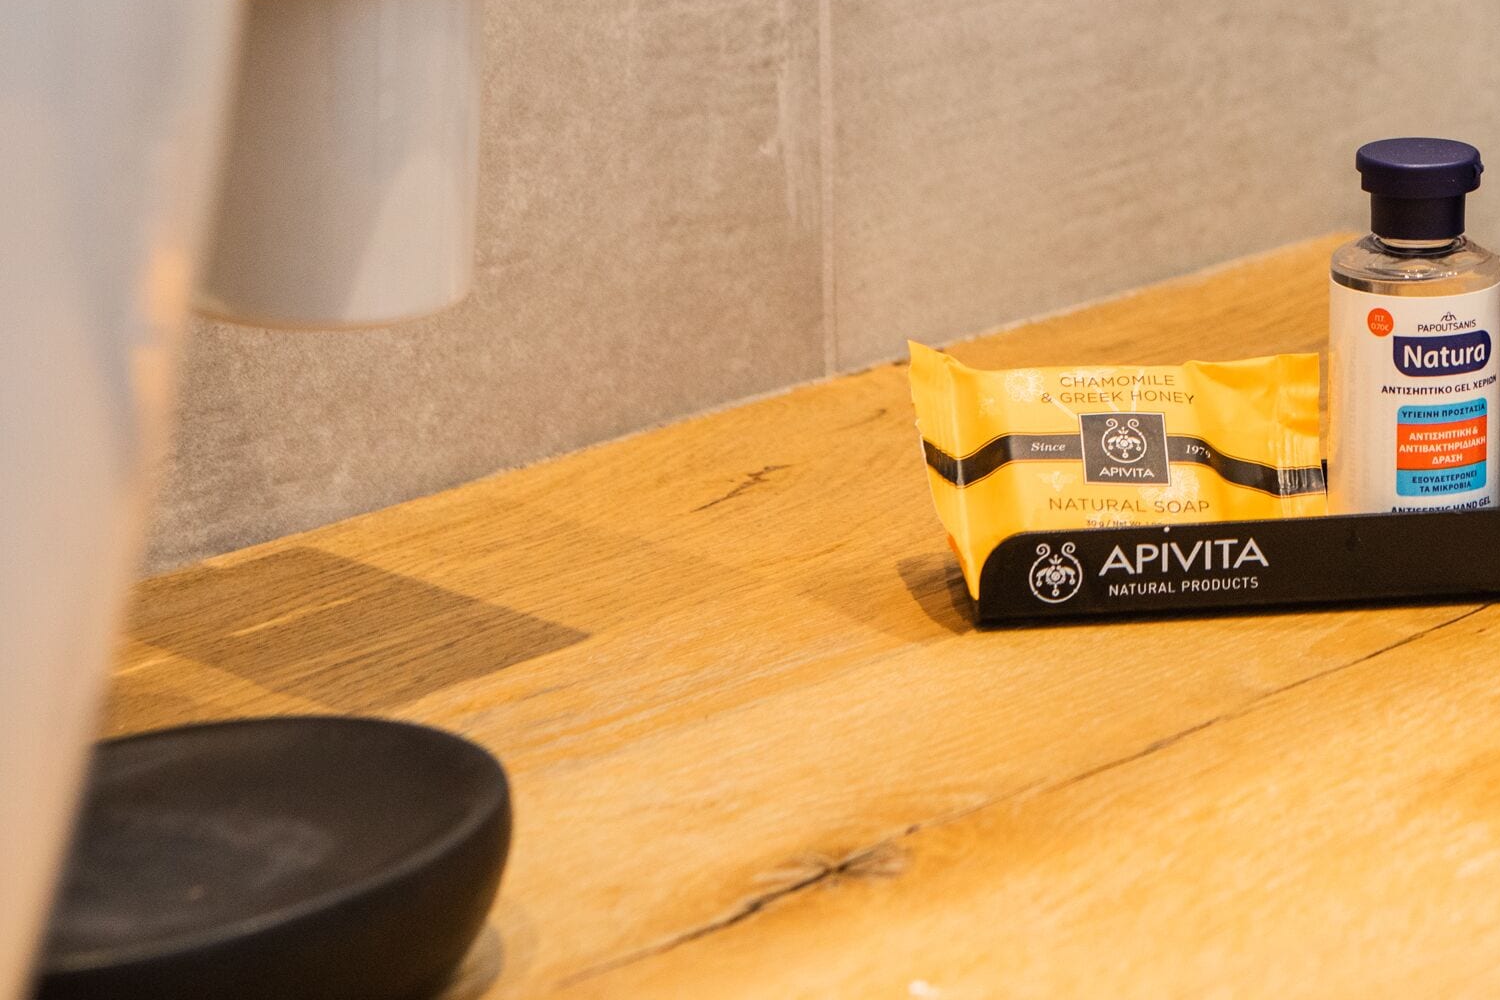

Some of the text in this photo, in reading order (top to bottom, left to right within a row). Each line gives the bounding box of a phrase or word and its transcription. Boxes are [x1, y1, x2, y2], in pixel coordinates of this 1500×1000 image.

[1417, 319, 1477, 333] PAPOUTSANIS
[1403, 343, 1486, 369] Natura
[1060, 375, 1175, 388] CHAMOMILE
[1381, 374, 1497, 395] ΑΝΤΙΣΗΠΤΙΚΟ GEL ΧΕΡΙΩΝ
[1041, 390, 1194, 405] & GREEK HONEY
[1402, 403, 1486, 419] ΥΓΙΕΙΝΗ ΠΡΟΣΤΑΣΙΑ
[1409, 426, 1479, 441] ΑΝΤΙΣΗΠΤΙΚΗ &
[1031, 441, 1066, 452] Since
[1399, 436, 1486, 453] ΑΝΤΙΒΑΚΤΗΡΙΔΙΑΚΗ
[1432, 454, 1463, 465] ΔΡΑΣΗ
[1099, 466, 1155, 478] APIVITA
[1411, 470, 1478, 484] ΕΞΟΥΔΕΤΕΡΩΝΕΙ
[1420, 481, 1472, 493] ΤΑ ΜΙΚΡΟΒΙΑ
[1049, 497, 1210, 514] NATURAL SOAP
[1453, 500, 1478, 511] HAND
[1478, 496, 1492, 507] GEL
[1099, 534, 1269, 576] APIVITA
[1108, 576, 1259, 597] NATURAL PRODUCTS
